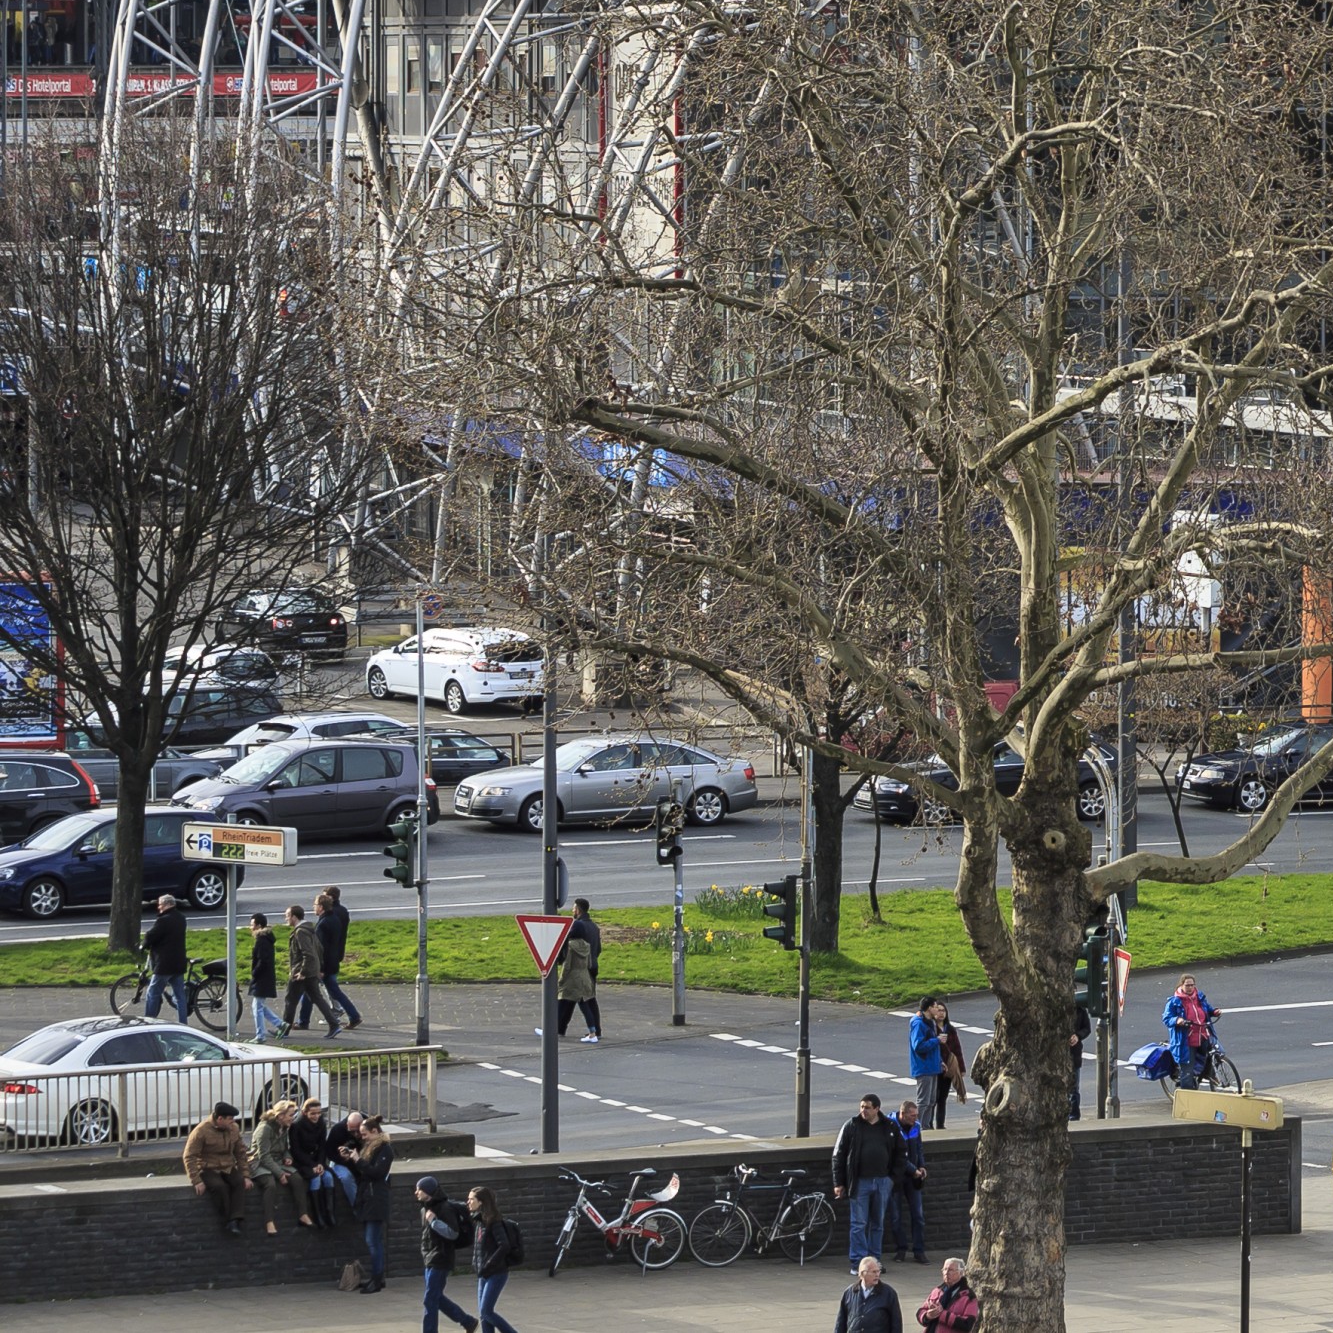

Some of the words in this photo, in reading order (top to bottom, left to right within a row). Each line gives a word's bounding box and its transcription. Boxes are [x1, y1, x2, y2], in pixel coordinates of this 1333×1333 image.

[222, 831, 272, 843] RheinTriadem
[222, 844, 244, 859] 222
[261, 849, 278, 858] Plätze
